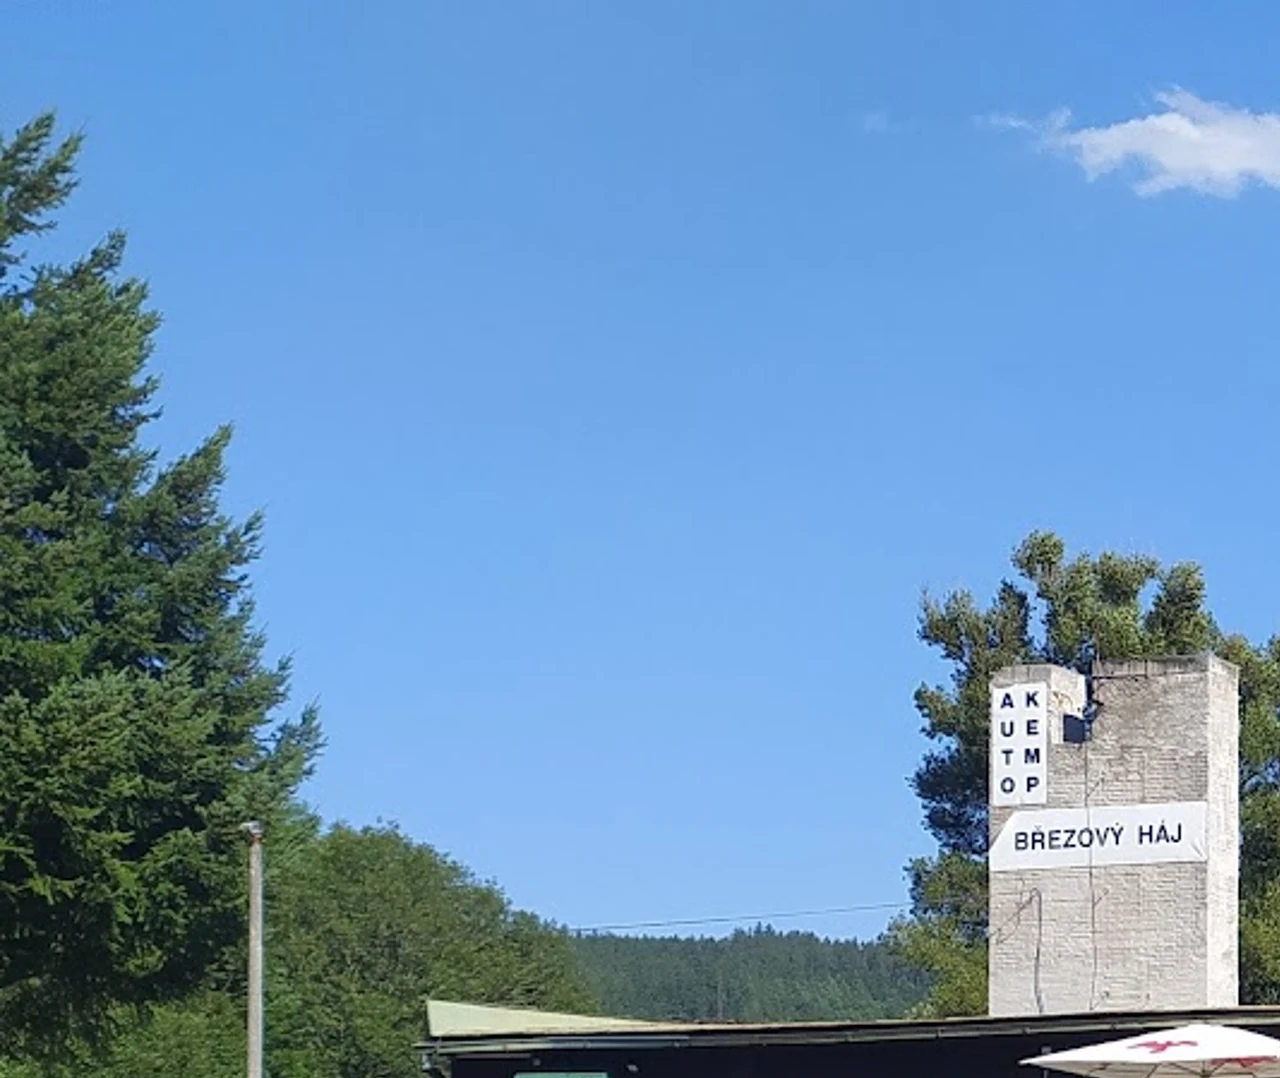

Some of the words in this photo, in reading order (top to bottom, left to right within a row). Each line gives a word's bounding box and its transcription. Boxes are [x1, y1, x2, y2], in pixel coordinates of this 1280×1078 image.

[1000, 692, 1015, 794] AUTO
[1024, 690, 1040, 793] KEMP
[1014, 822, 1124, 850] BŘEZOVÝ
[1138, 819, 1182, 844] HÁJ
